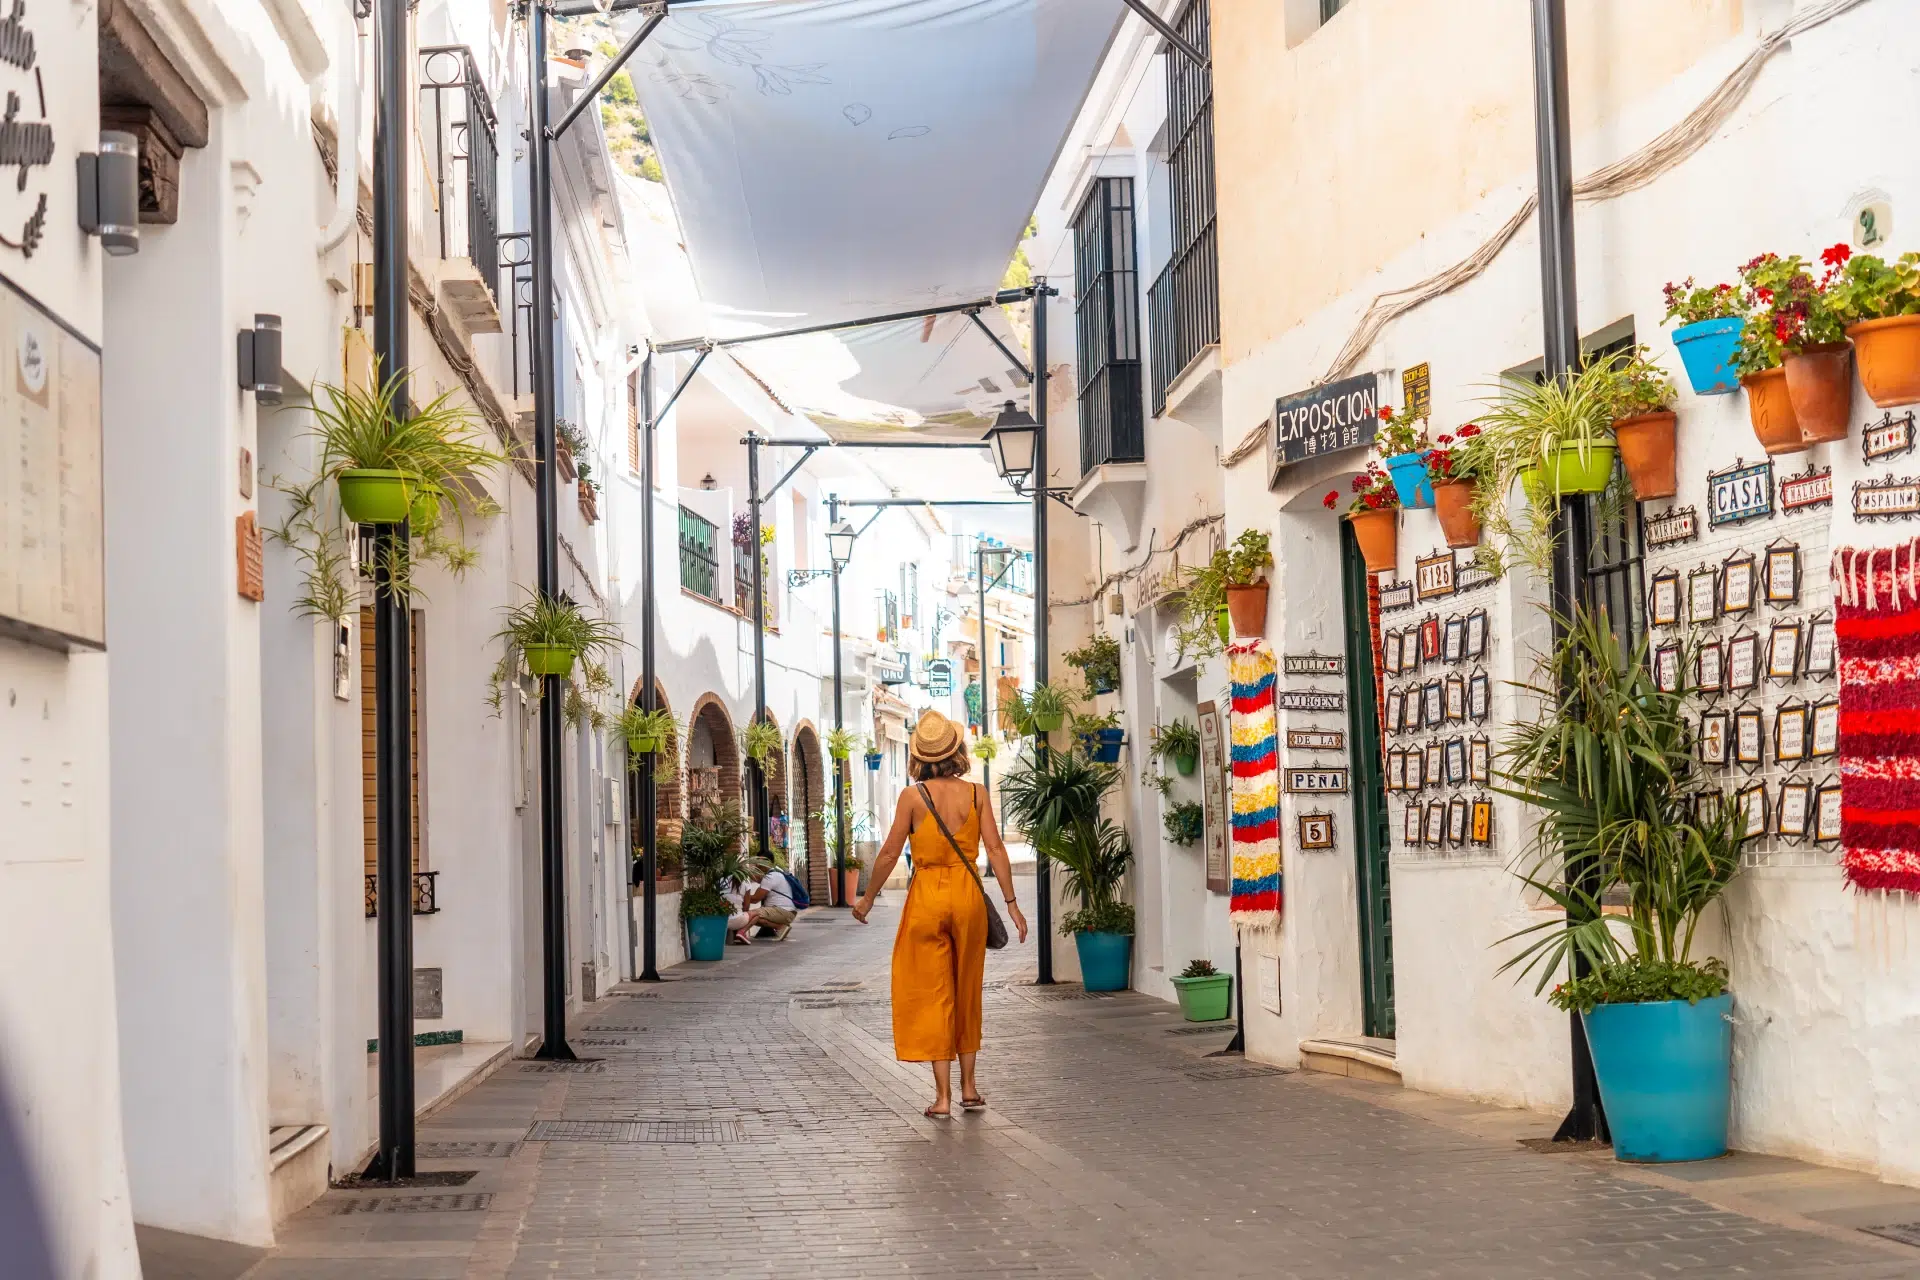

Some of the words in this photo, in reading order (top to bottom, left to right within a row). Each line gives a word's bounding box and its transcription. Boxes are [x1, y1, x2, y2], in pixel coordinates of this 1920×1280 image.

[1279, 387, 1376, 443] EXPOSICION
[1303, 424, 1360, 456] 博物館
[1718, 475, 1764, 513] CASA
[1871, 492, 1906, 508] SPAIN
[1653, 519, 1685, 539] MIRIAM
[1291, 659, 1328, 670] VILLA
[1290, 695, 1335, 707] VIRGEN
[1297, 735, 1311, 745] DE
[1321, 736, 1335, 746] LA
[1295, 773, 1340, 789] PEÑA
[1310, 823, 1322, 841] 5
